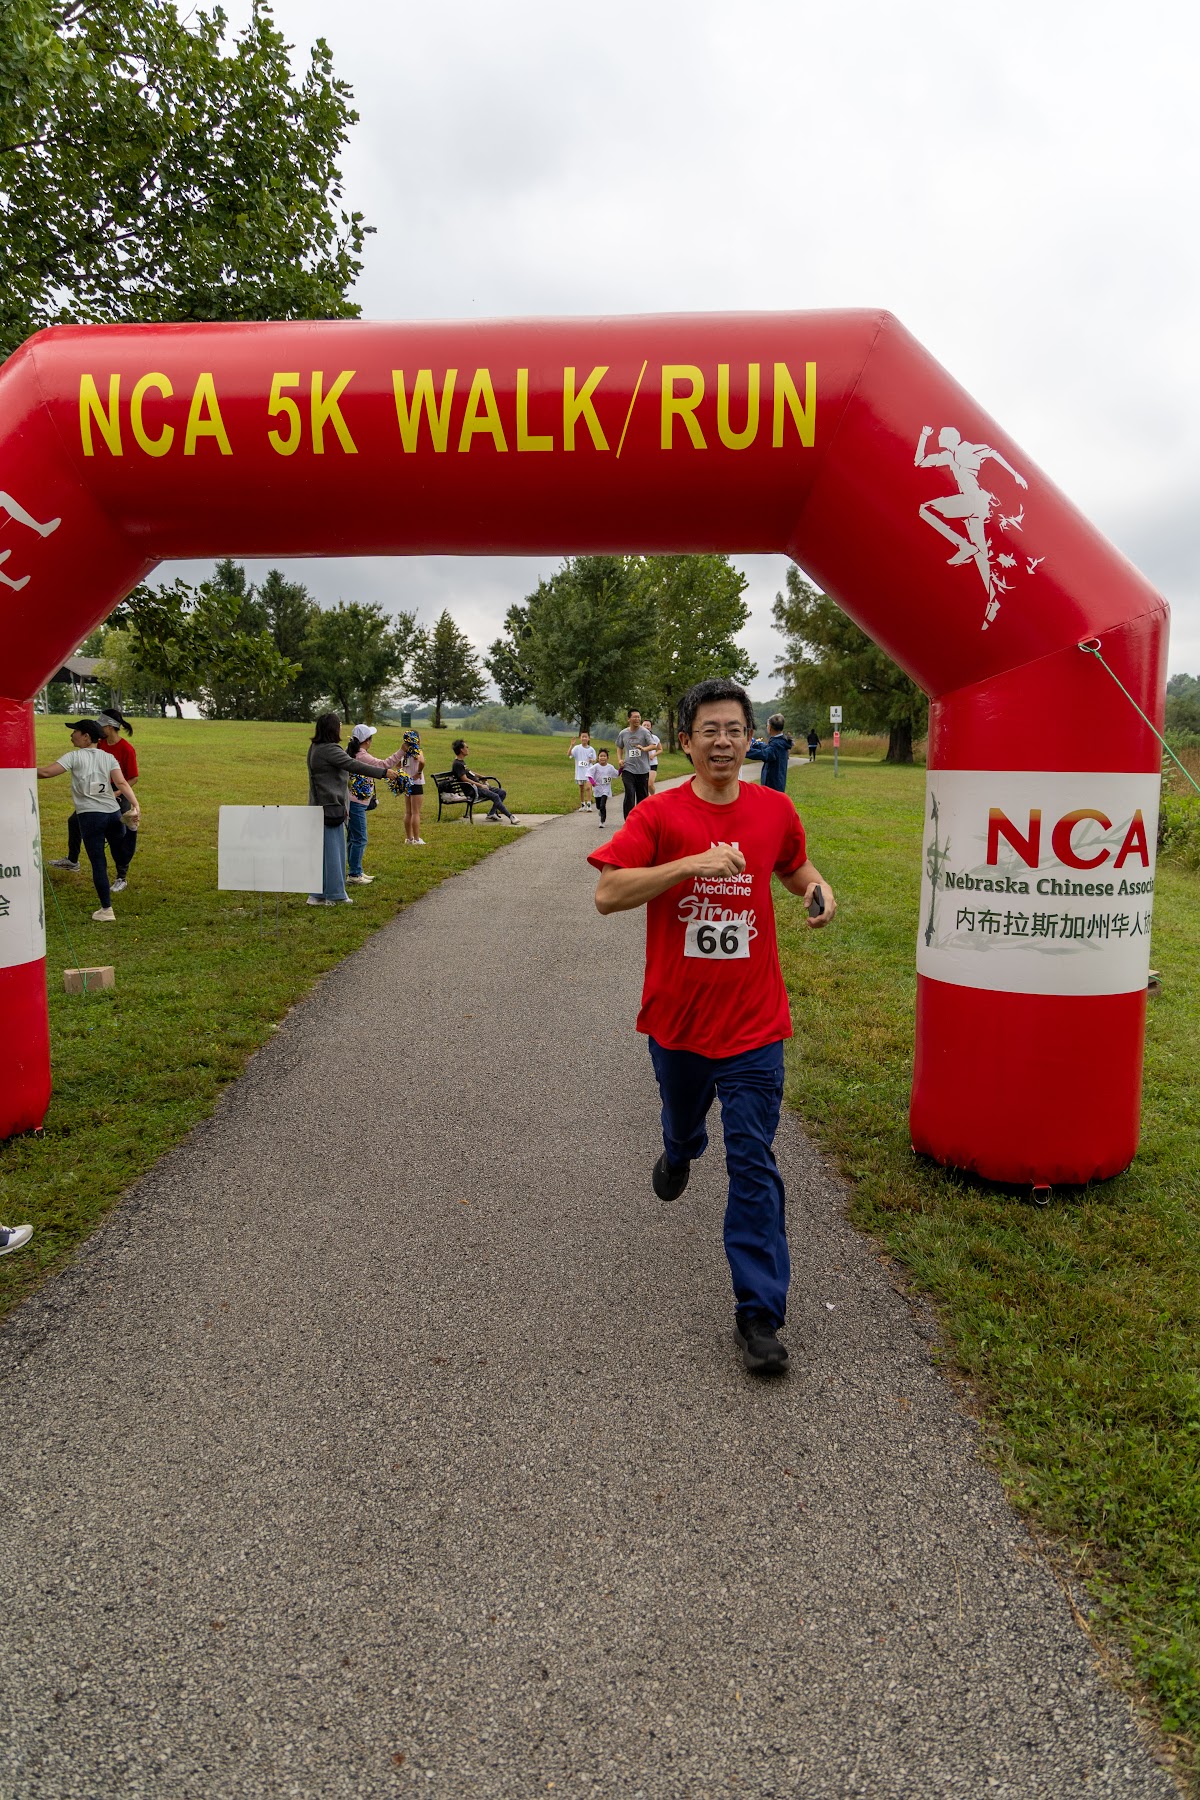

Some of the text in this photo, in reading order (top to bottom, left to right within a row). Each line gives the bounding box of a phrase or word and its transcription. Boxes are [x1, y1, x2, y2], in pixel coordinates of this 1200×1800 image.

[79, 360, 817, 459] NCA 5K WALK/RUN
[98, 783, 106, 794] 2
[986, 807, 1149, 870] NCA
[693, 882, 752, 897] Medicine
[945, 871, 1030, 895] Nebraska
[1036, 877, 1114, 896] Chinese
[696, 925, 739, 955] 66
